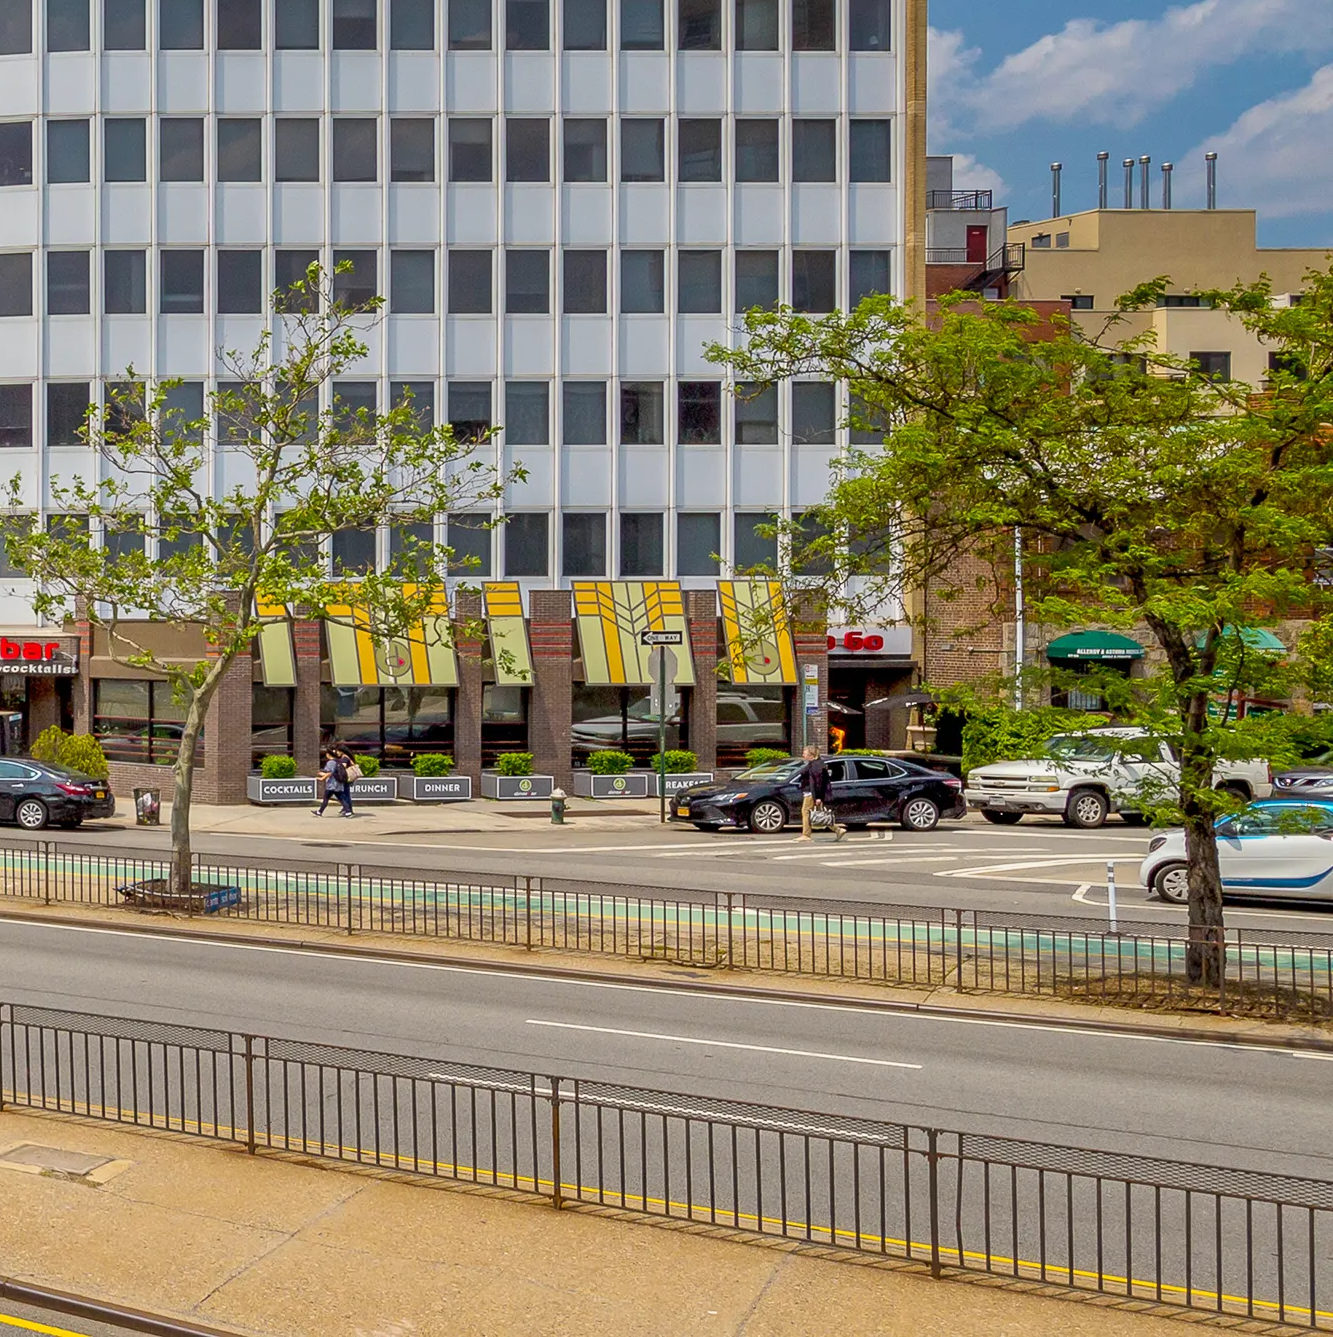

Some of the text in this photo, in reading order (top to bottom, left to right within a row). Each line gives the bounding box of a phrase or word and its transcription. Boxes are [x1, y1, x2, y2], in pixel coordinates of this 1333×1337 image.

[2, 663, 72, 675] cocktails
[263, 785, 313, 794] COCKTAILS
[424, 783, 461, 792] DINNER
